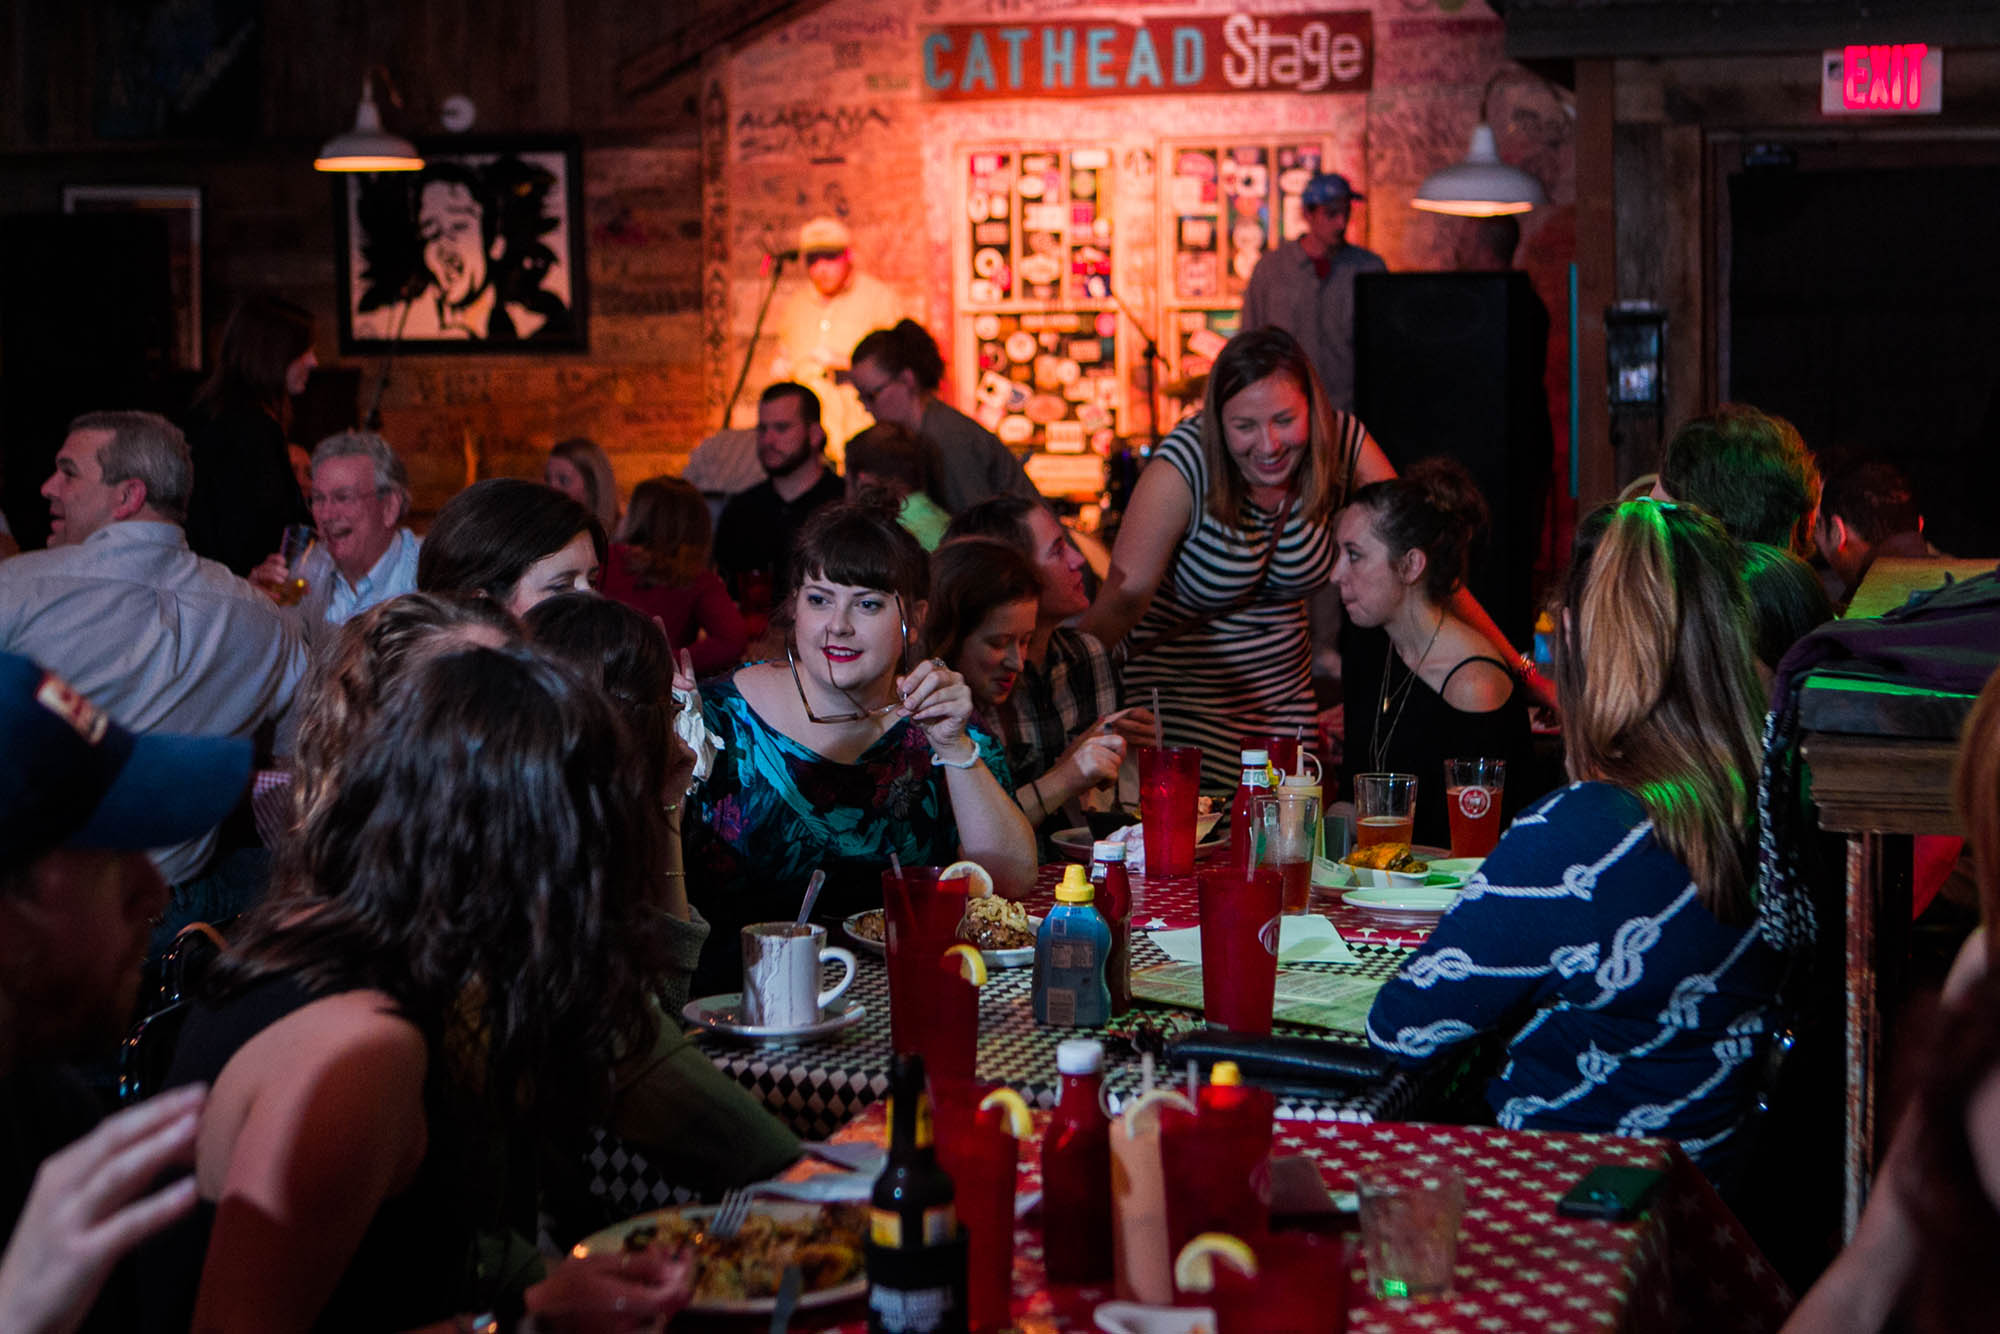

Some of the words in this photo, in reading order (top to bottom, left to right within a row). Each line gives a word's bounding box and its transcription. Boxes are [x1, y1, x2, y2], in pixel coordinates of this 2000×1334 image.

[923, 27, 1205, 91] CATHEAD
[1221, 13, 1363, 92] Stage
[1843, 43, 1928, 110] EXIT
